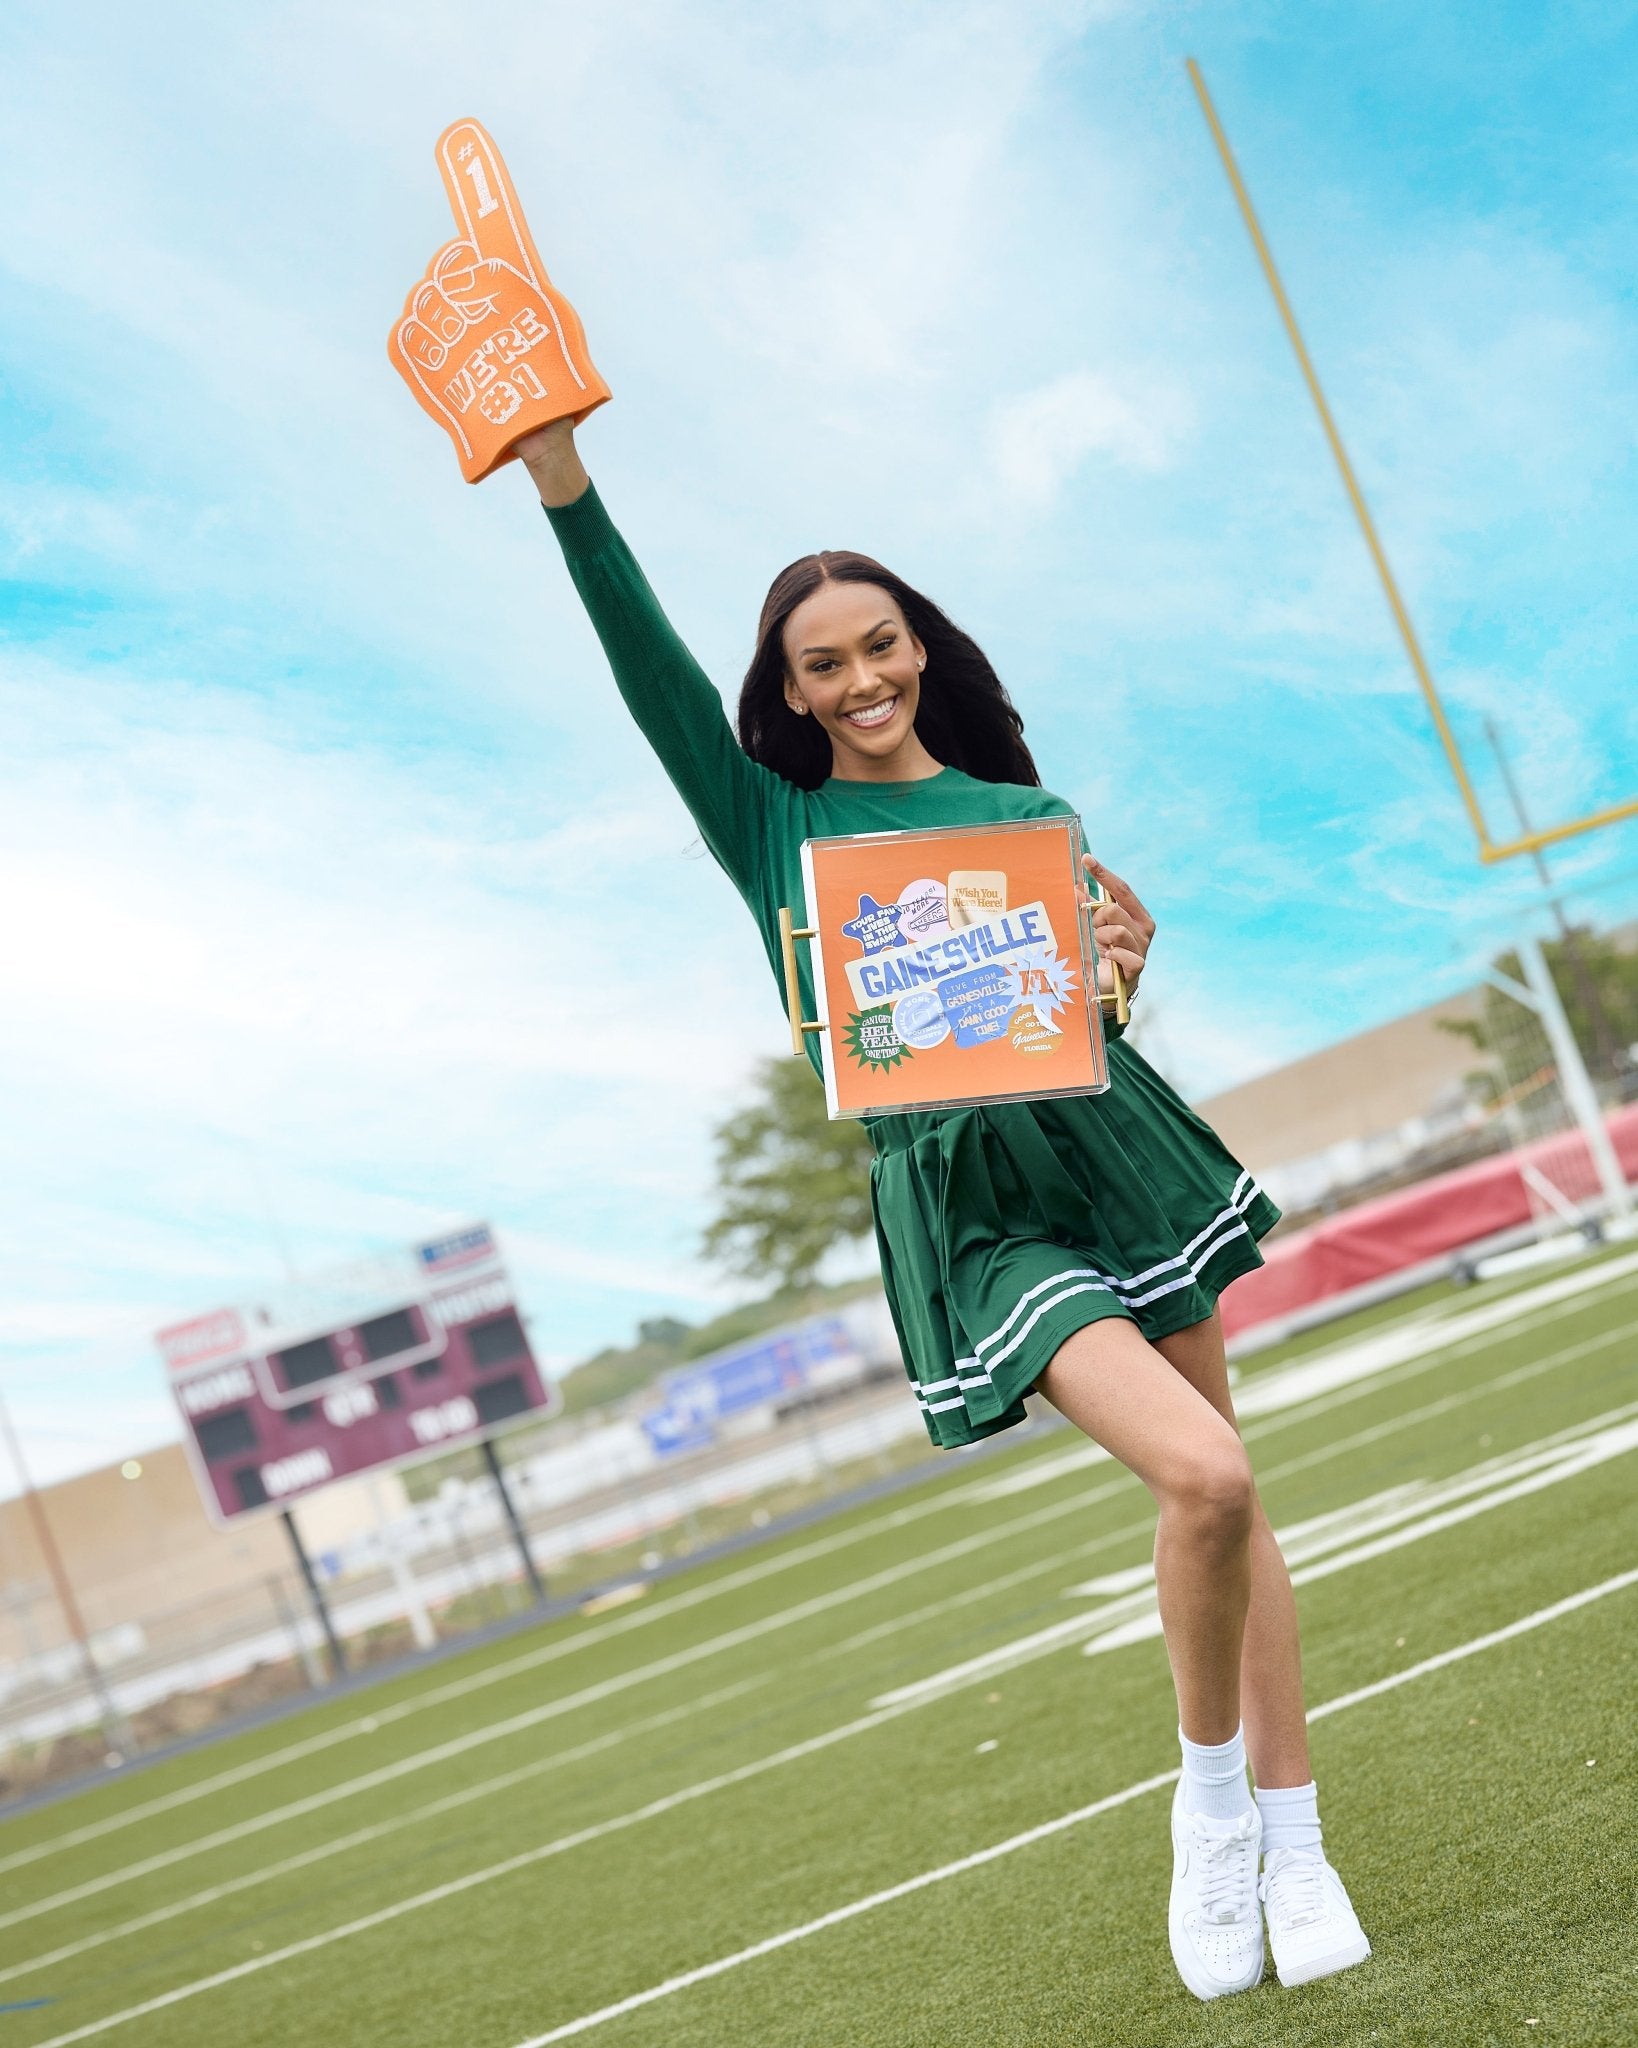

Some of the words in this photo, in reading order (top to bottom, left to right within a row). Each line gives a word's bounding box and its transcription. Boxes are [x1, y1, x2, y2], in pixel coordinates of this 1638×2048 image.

[444, 307, 550, 415] WE'RE
[480, 362, 548, 425] #1
[955, 887, 979, 899] Wish
[980, 888, 998, 899] You
[977, 898, 1002, 908] Here!
[850, 913, 875, 931] YOUR
[861, 917, 891, 933] LIVES
[863, 932, 874, 942] IN
[879, 924, 896, 937] THE
[865, 930, 898, 949] SWAMP
[859, 910, 1047, 998] GAINESVILLE
[945, 982, 967, 994] LIVE
[973, 972, 997, 985] FROM
[946, 981, 1005, 1008] GAINESVILLE
[991, 999, 996, 1007] A
[959, 1013, 983, 1028] DAMN
[984, 1005, 1008, 1020] GOOD
